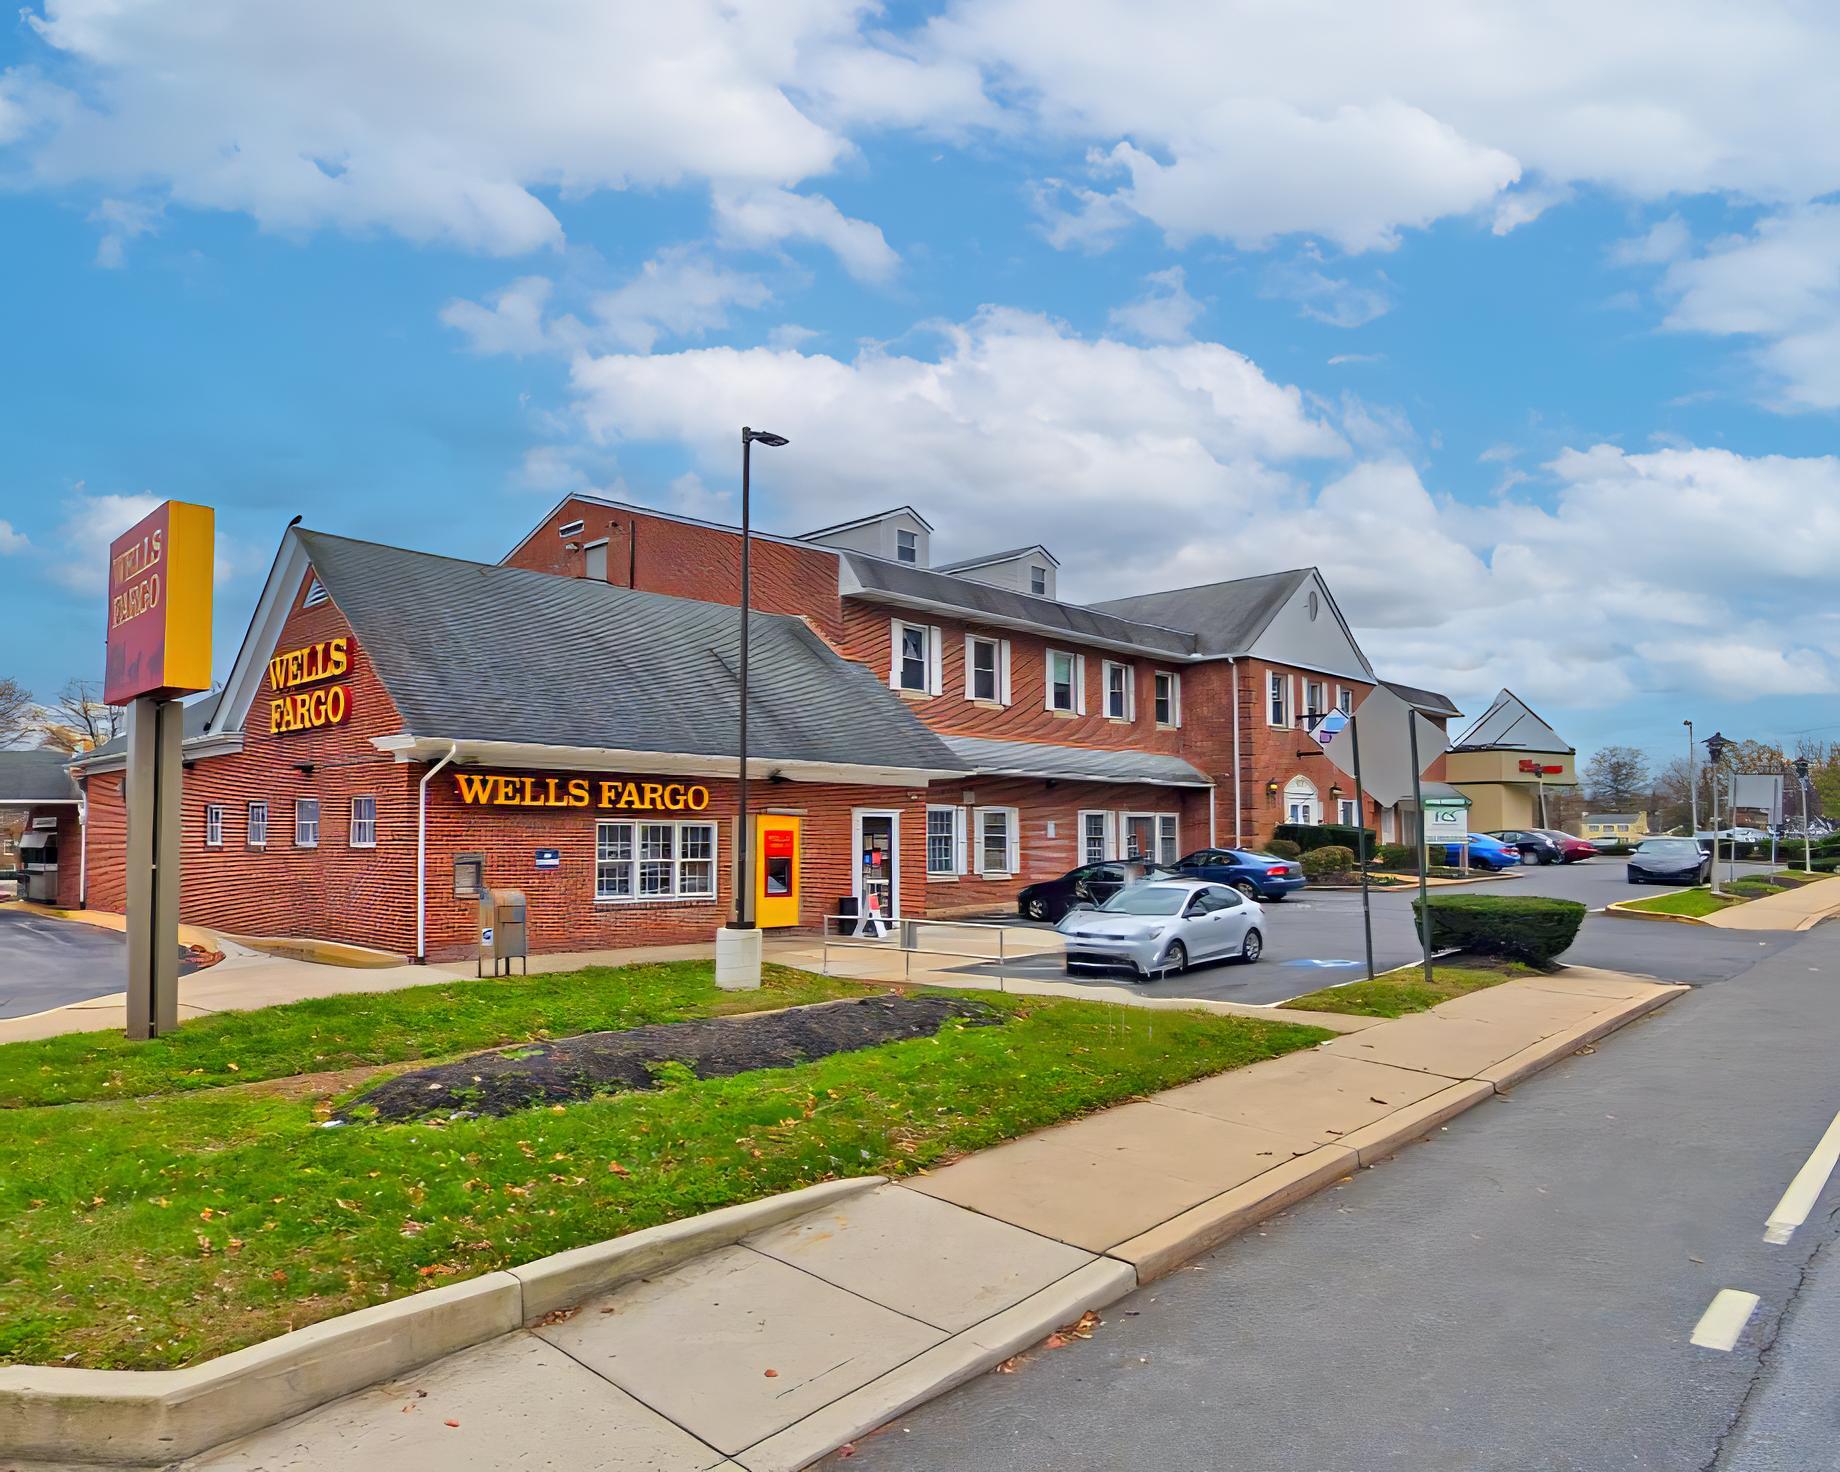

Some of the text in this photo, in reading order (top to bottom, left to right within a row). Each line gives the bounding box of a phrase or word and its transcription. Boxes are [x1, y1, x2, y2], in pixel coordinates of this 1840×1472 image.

[113, 529, 161, 587] WELLS
[112, 574, 160, 629] FARGO
[269, 638, 347, 690] WELLS
[269, 686, 346, 734] FARGO
[455, 774, 710, 811] WELLS FARGO
